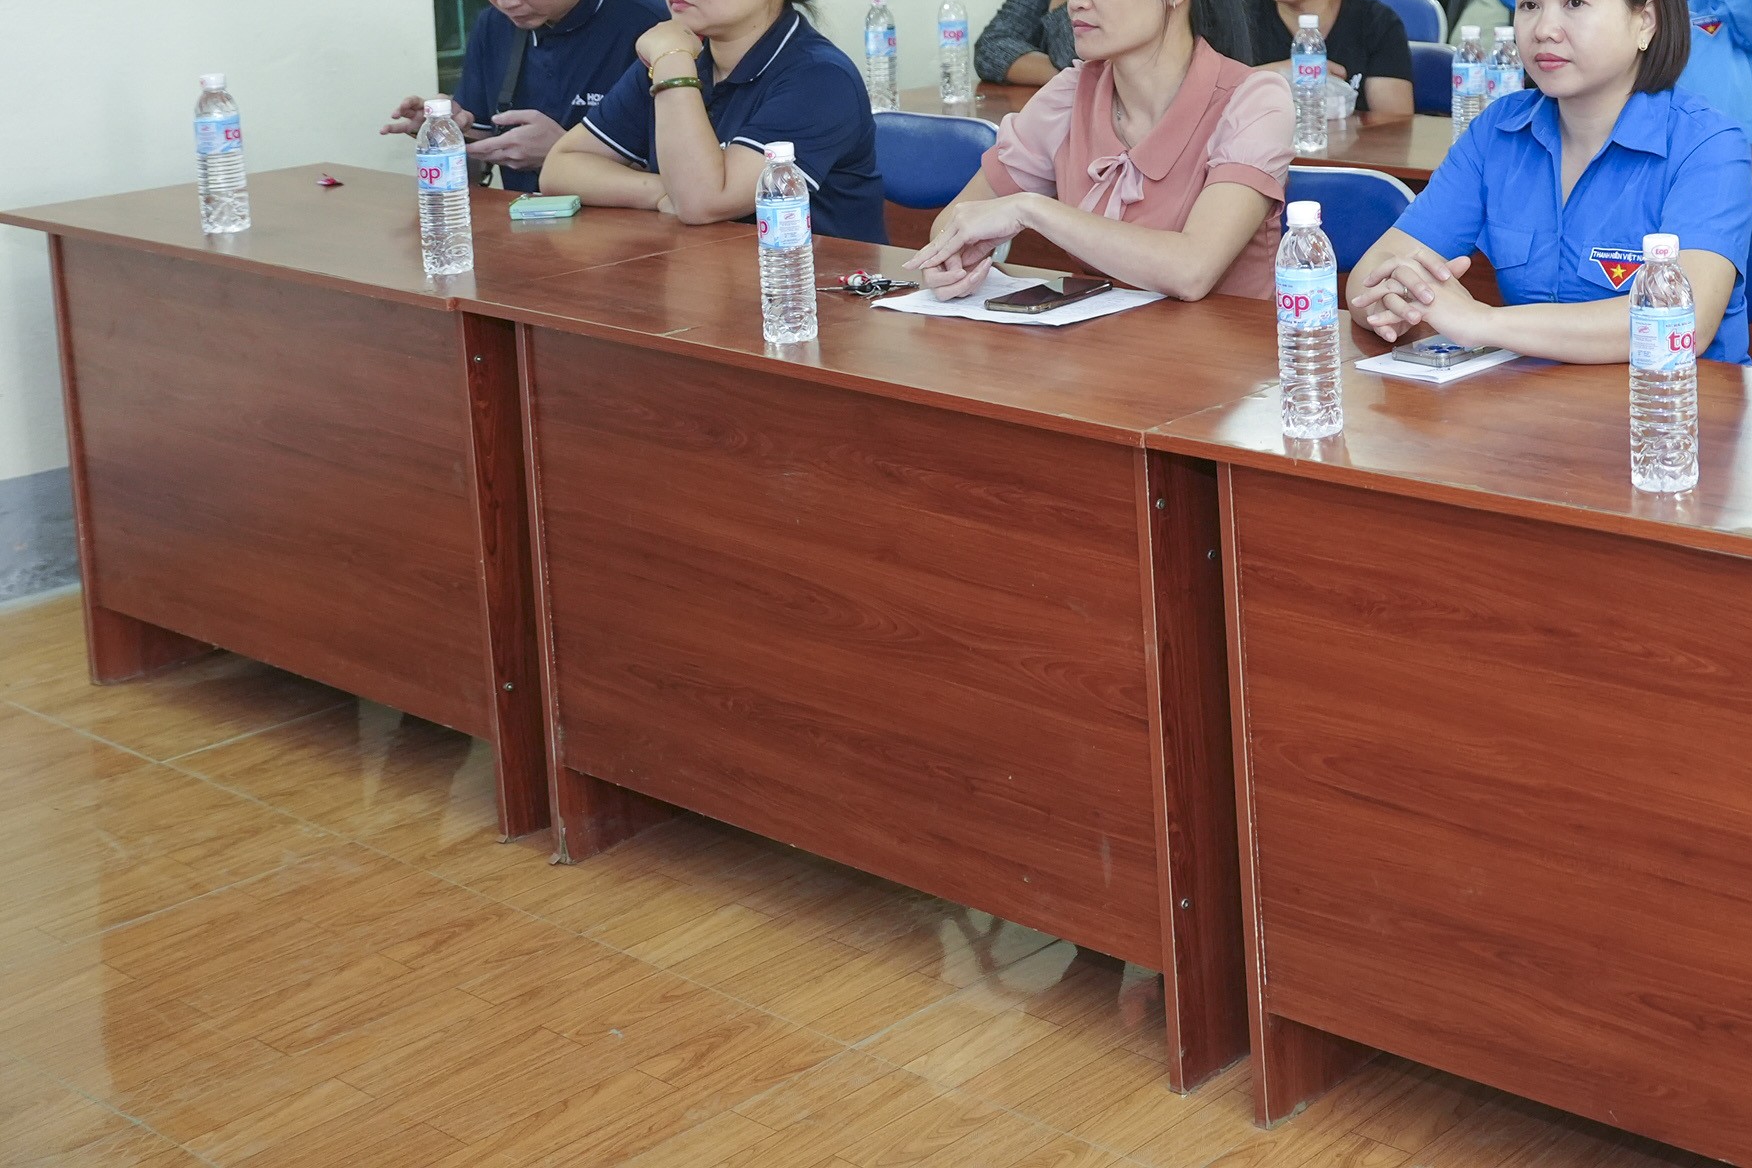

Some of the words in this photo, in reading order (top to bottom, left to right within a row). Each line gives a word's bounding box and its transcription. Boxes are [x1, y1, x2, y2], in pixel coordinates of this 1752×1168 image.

[943, 30, 964, 42] top
[1298, 64, 1322, 79] top
[224, 128, 241, 141] to
[417, 166, 442, 185] op
[1655, 247, 1669, 257] top
